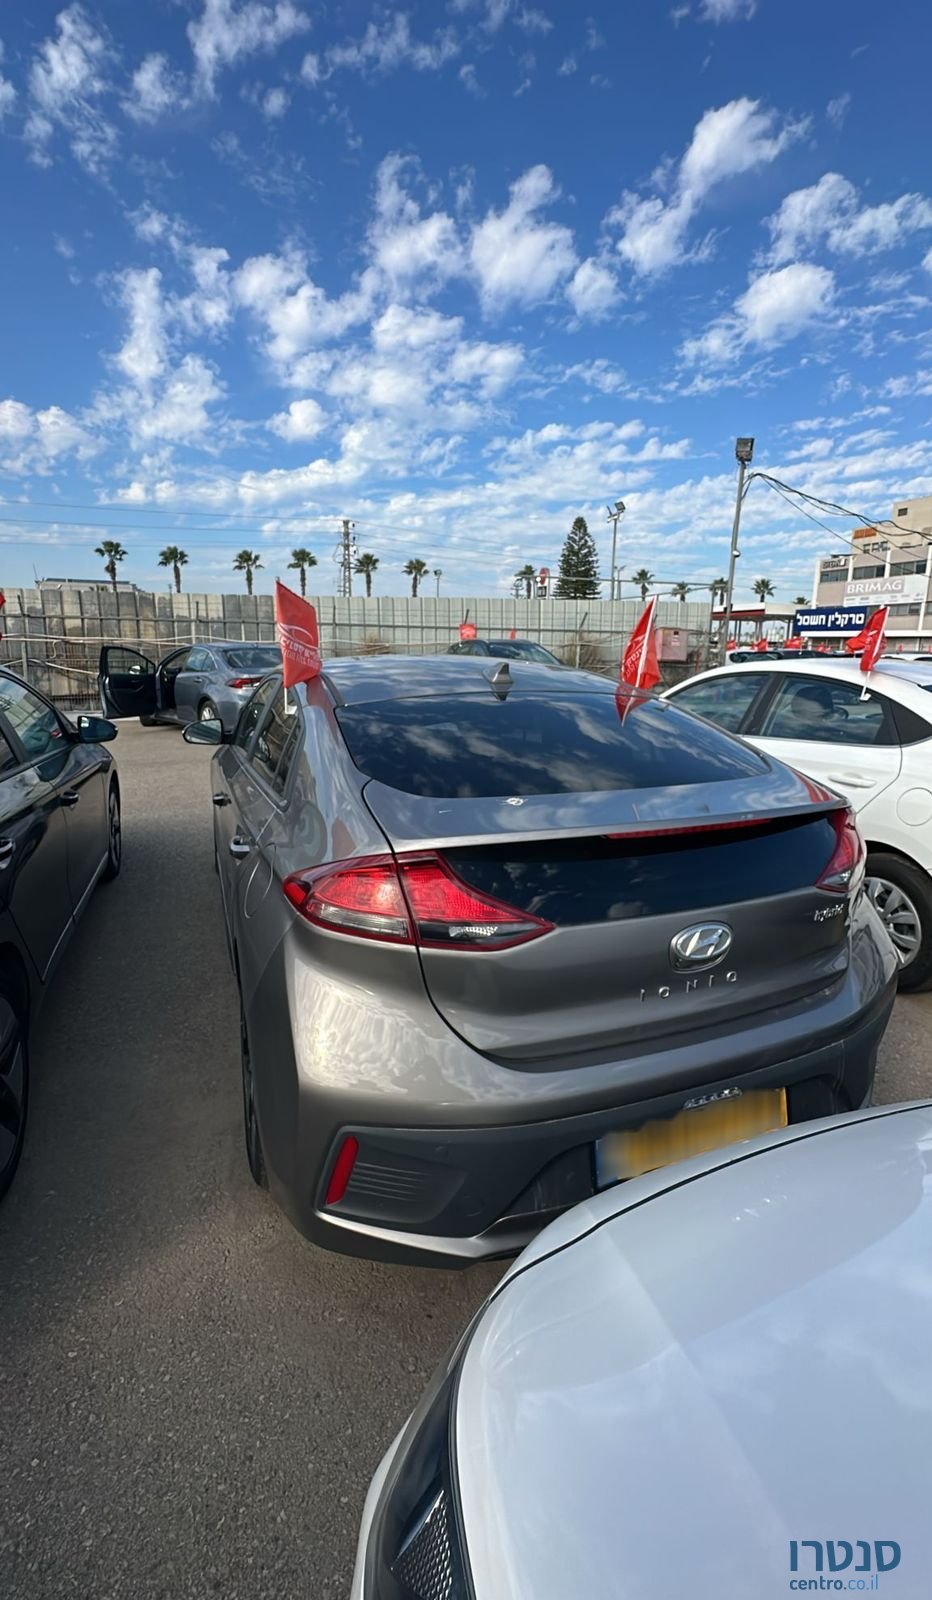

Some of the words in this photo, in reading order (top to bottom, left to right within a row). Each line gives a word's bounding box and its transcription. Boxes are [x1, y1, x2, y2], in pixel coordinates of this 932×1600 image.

[847, 580, 902, 594] BRIMAG
[814, 903, 844, 922] hybrid
[640, 971, 737, 1002] IONIQ
